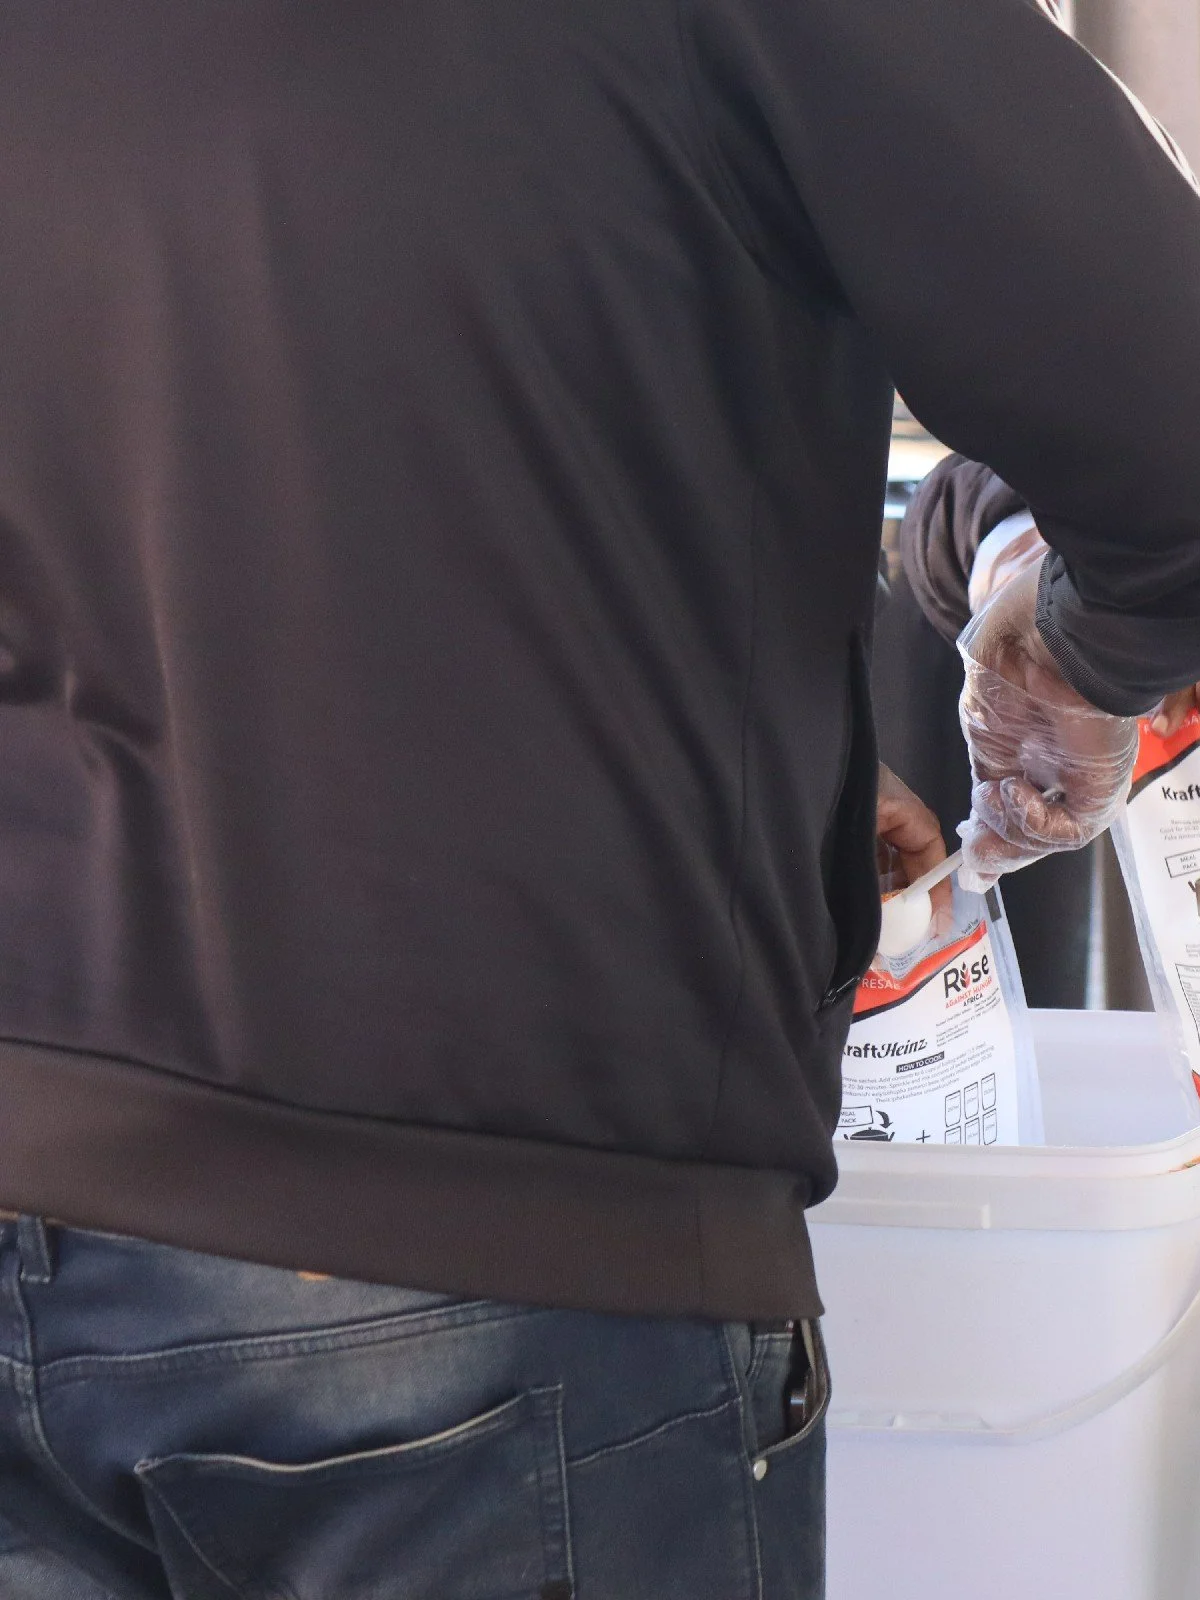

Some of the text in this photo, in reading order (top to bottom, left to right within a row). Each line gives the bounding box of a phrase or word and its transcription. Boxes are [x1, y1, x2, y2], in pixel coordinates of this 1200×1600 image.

[843, 1038, 927, 1058] raftHeinz
[898, 1061, 916, 1073] HOW
[916, 1059, 924, 1068] TO
